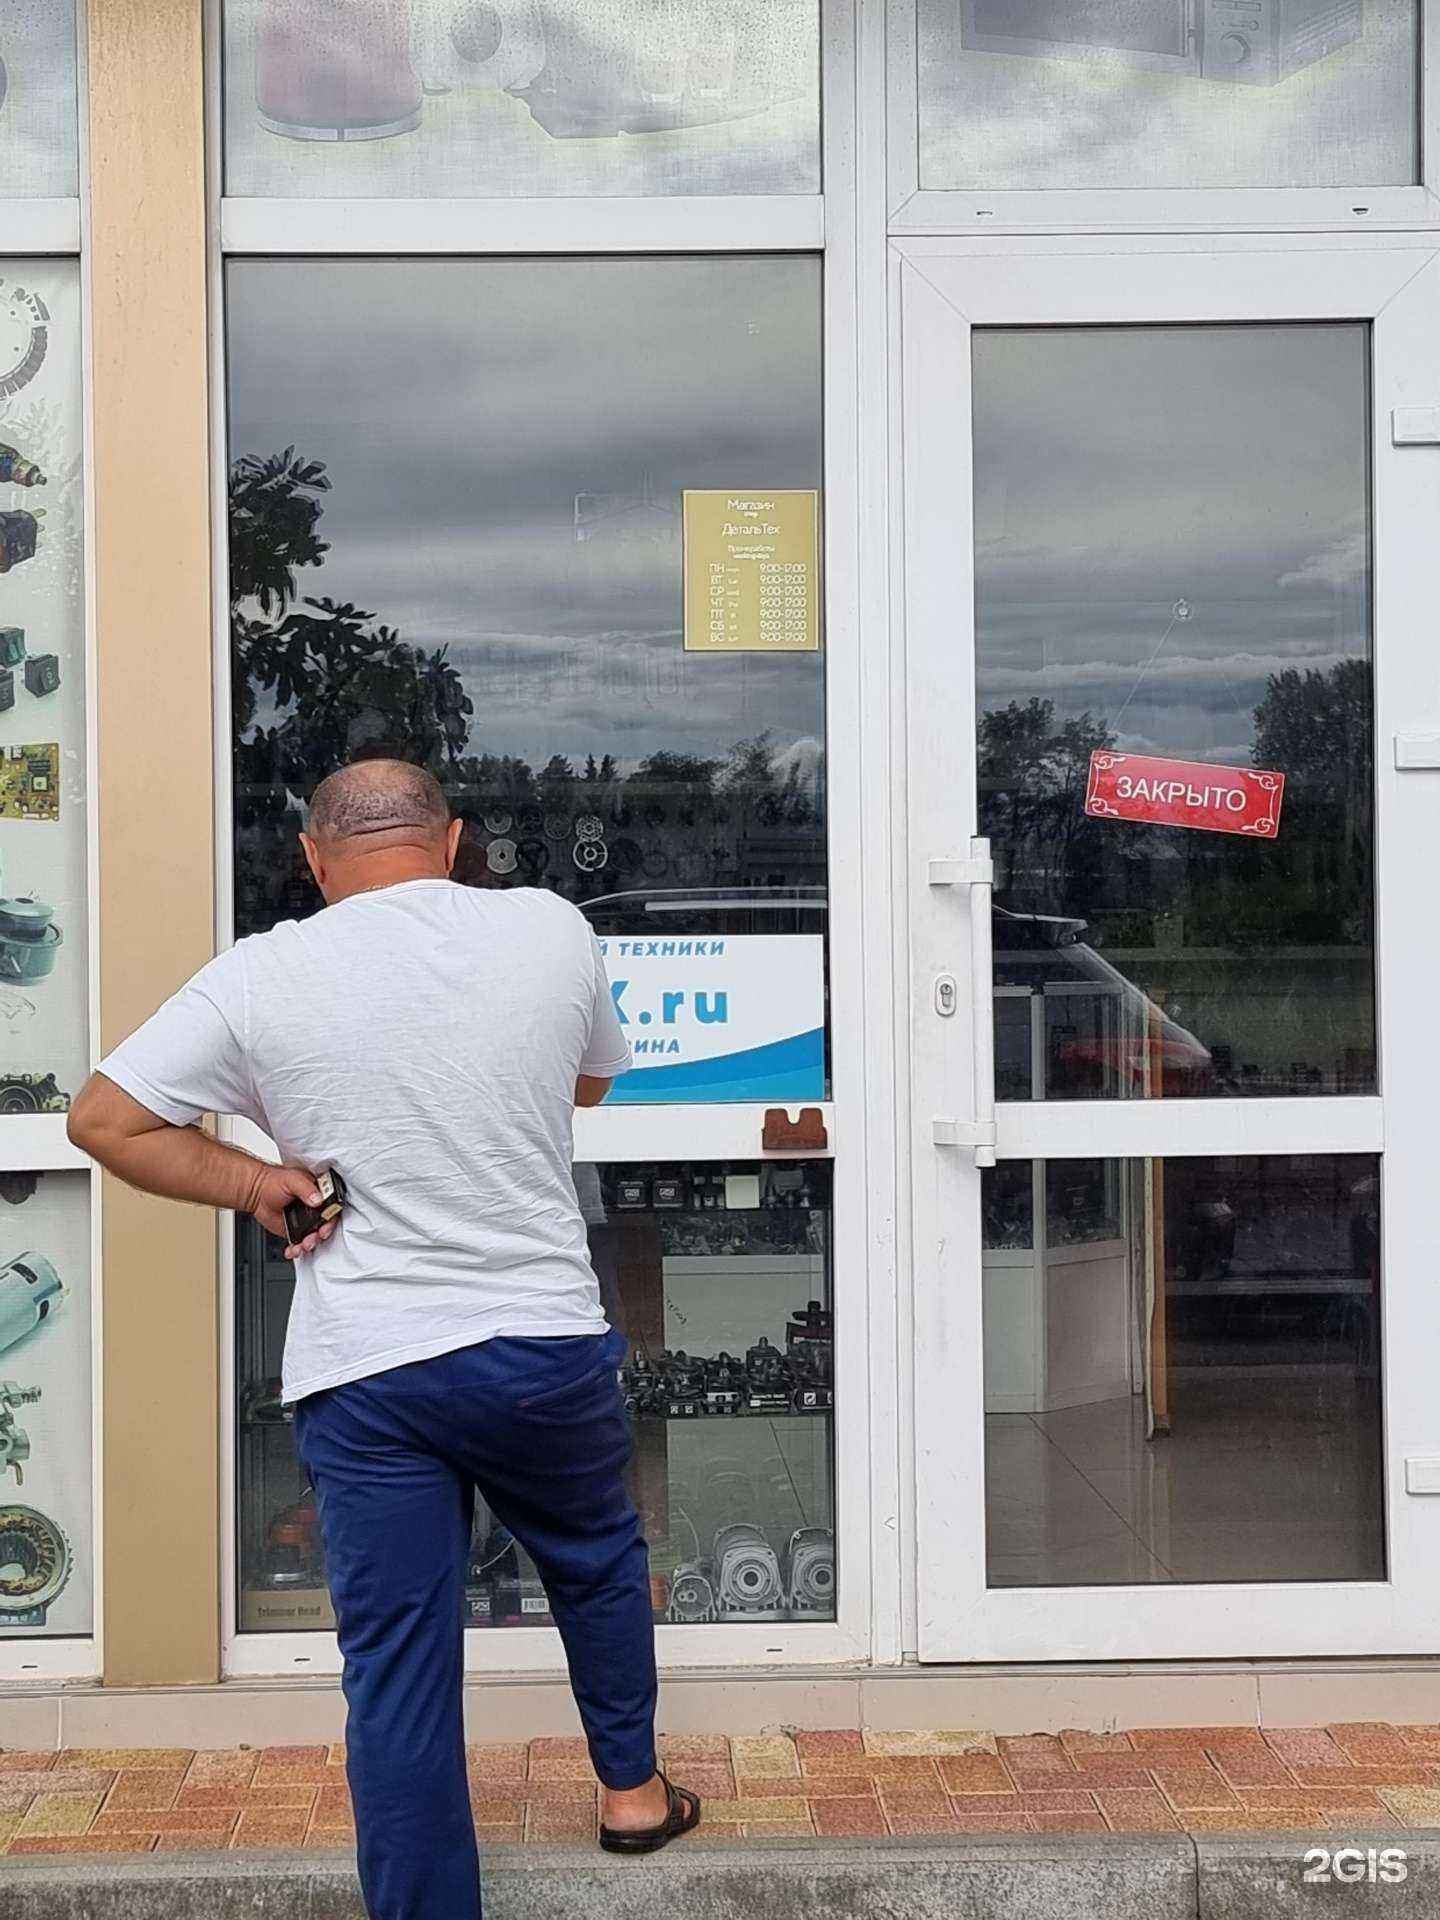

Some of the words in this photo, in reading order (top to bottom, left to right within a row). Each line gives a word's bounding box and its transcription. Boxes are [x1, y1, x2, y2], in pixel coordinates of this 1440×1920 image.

[727, 499, 775, 511] Магазин
[722, 523, 780, 536] ДетальТех
[1116, 775, 1247, 812] ЗАКРЫТО
[618, 941, 725, 956] ТЕХНИКИ
[627, 1039, 681, 1054] ИНА
